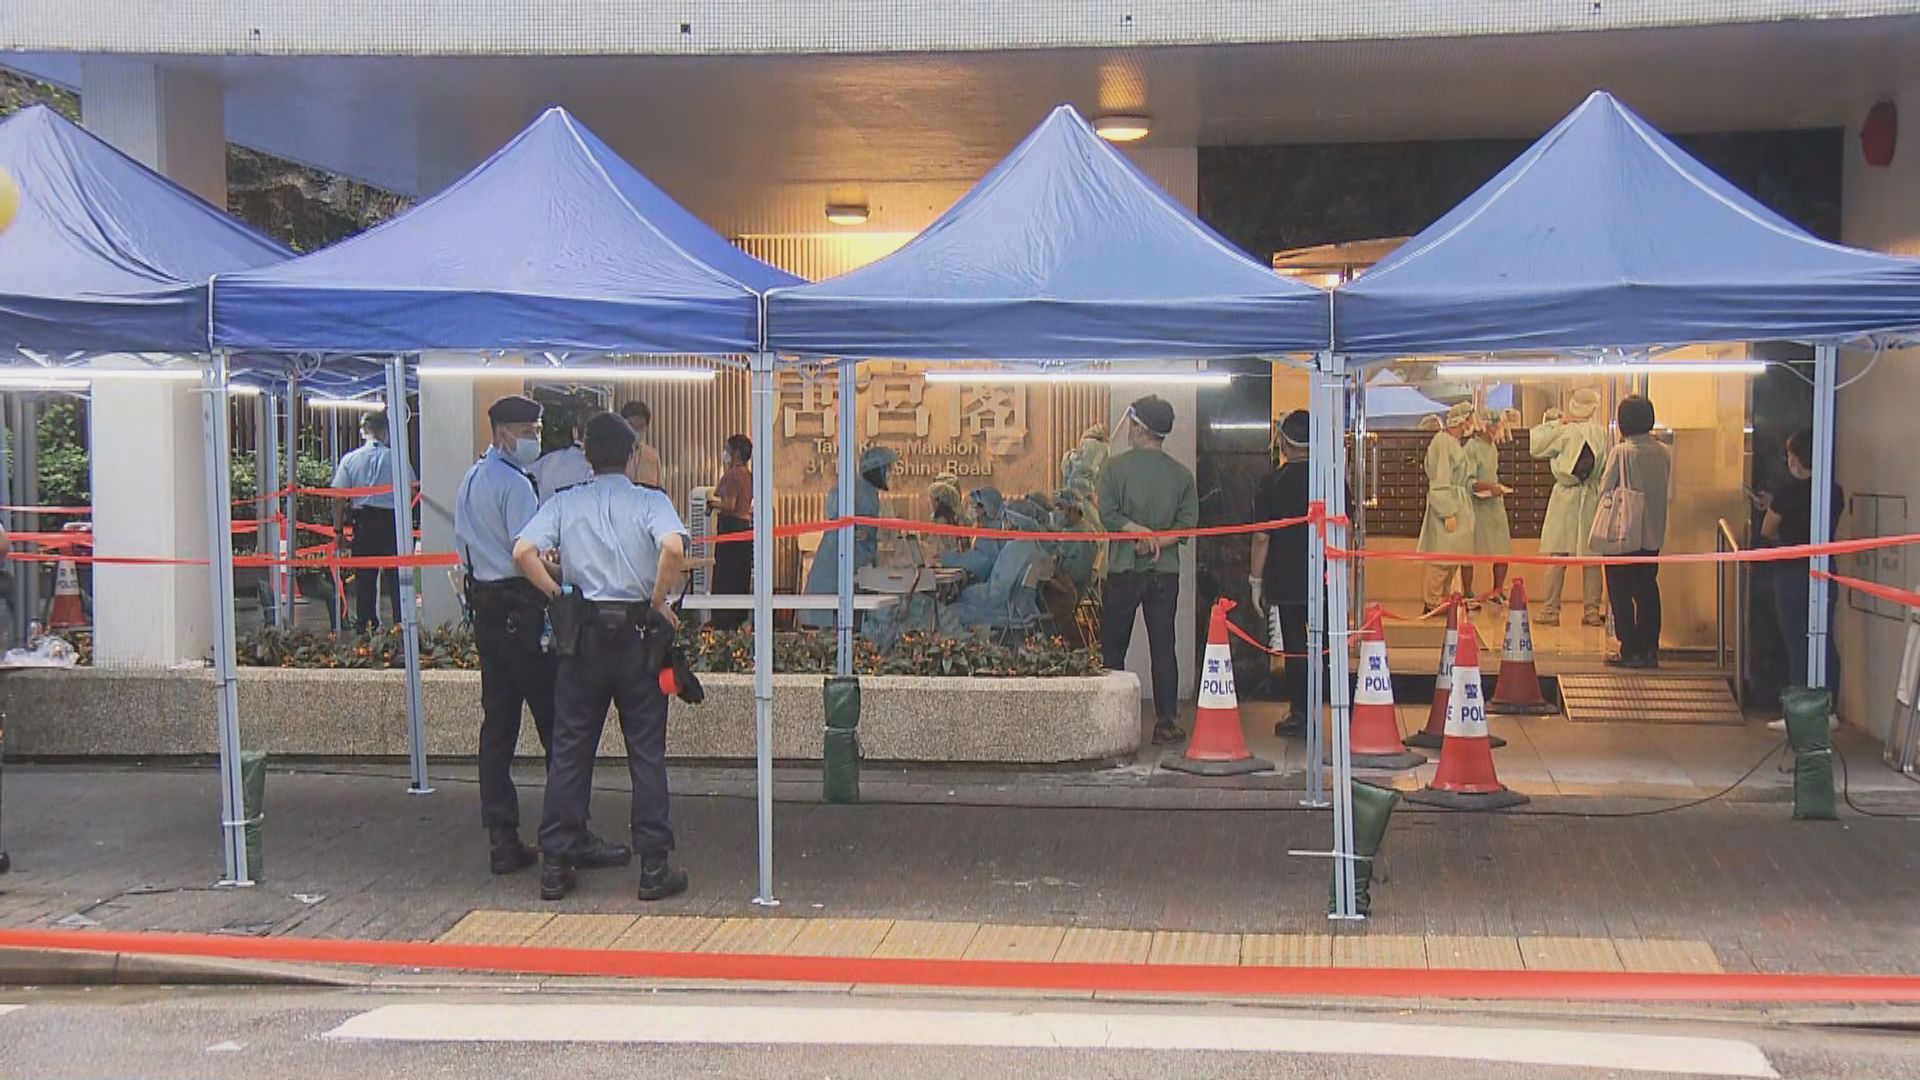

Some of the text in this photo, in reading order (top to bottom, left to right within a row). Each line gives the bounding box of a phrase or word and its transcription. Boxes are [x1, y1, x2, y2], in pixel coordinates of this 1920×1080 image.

[906, 439, 979, 456] Mansion
[806, 459, 825, 474] 31
[895, 460, 943, 475] Shing
[946, 460, 992, 475] Road
